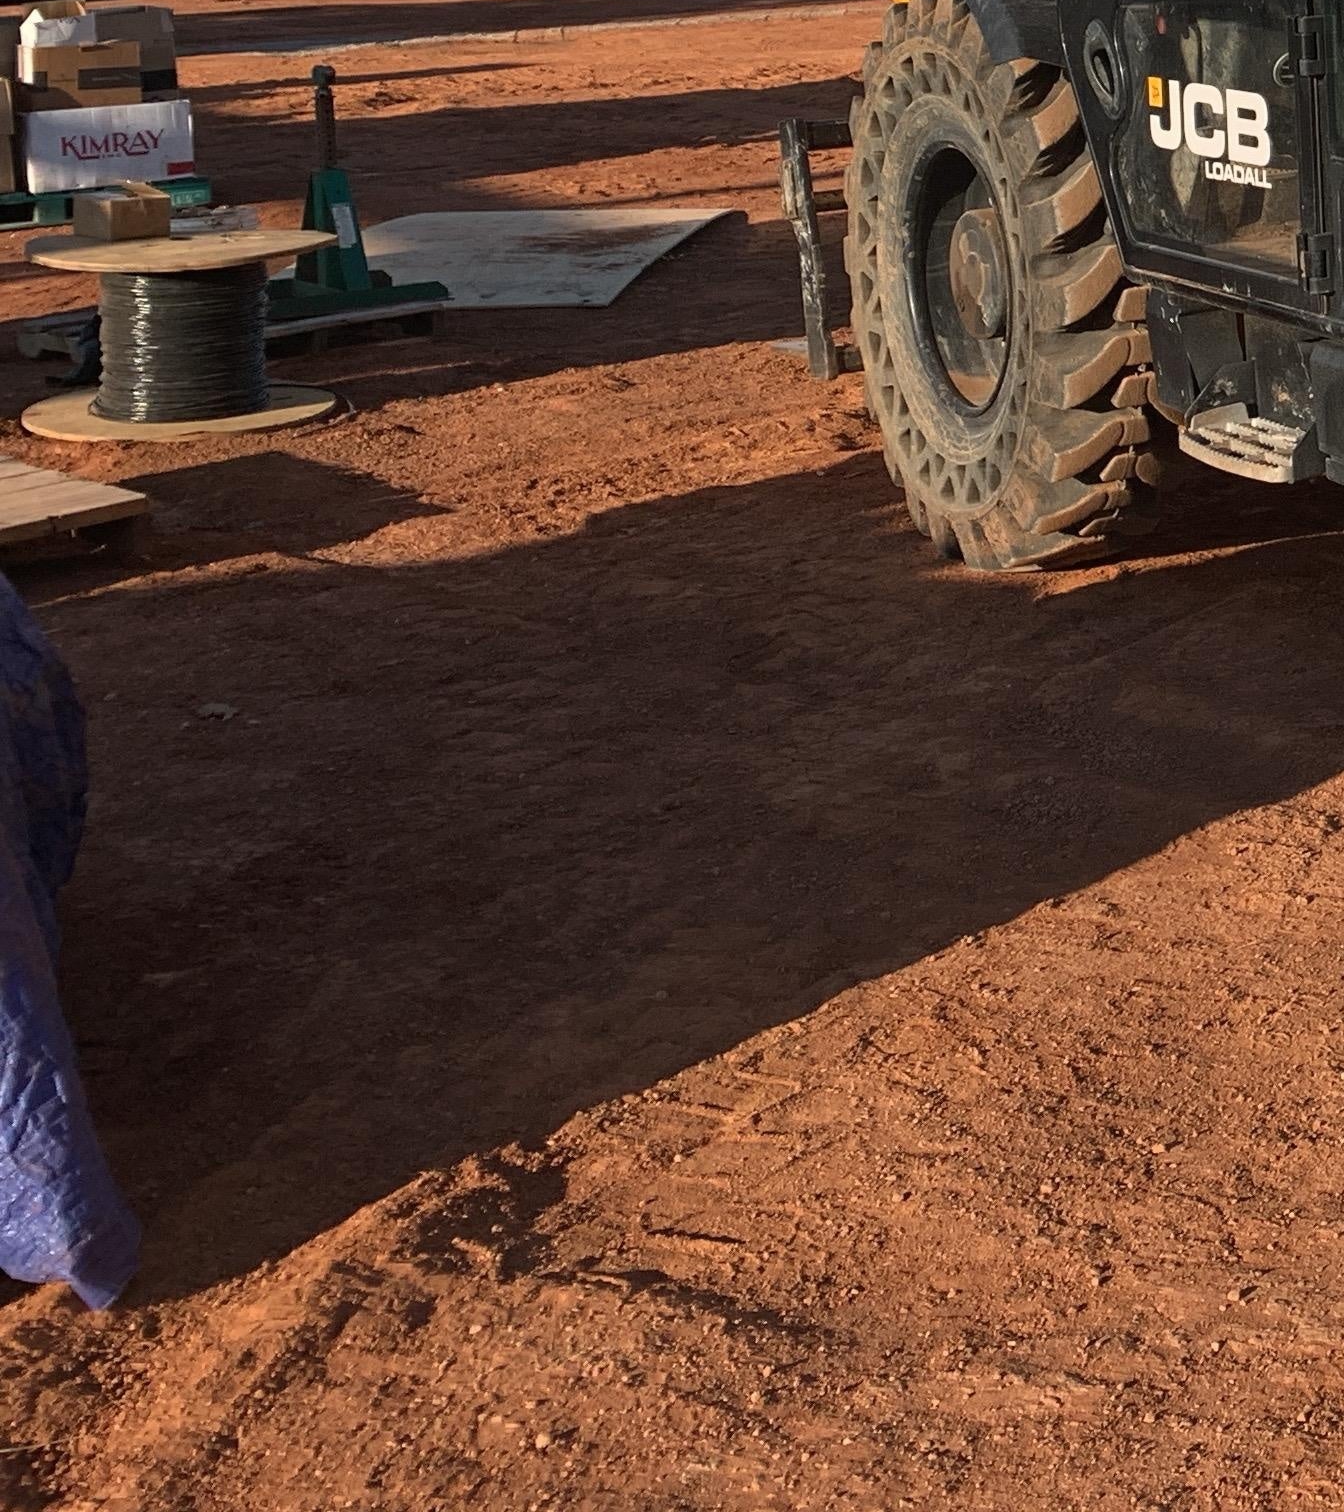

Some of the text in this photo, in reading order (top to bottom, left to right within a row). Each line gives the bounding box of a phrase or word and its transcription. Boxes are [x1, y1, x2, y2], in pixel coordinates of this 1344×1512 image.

[1149, 79, 1271, 167] JCB
[60, 128, 164, 160] KIMRAY
[1205, 160, 1273, 189] LOADALL
